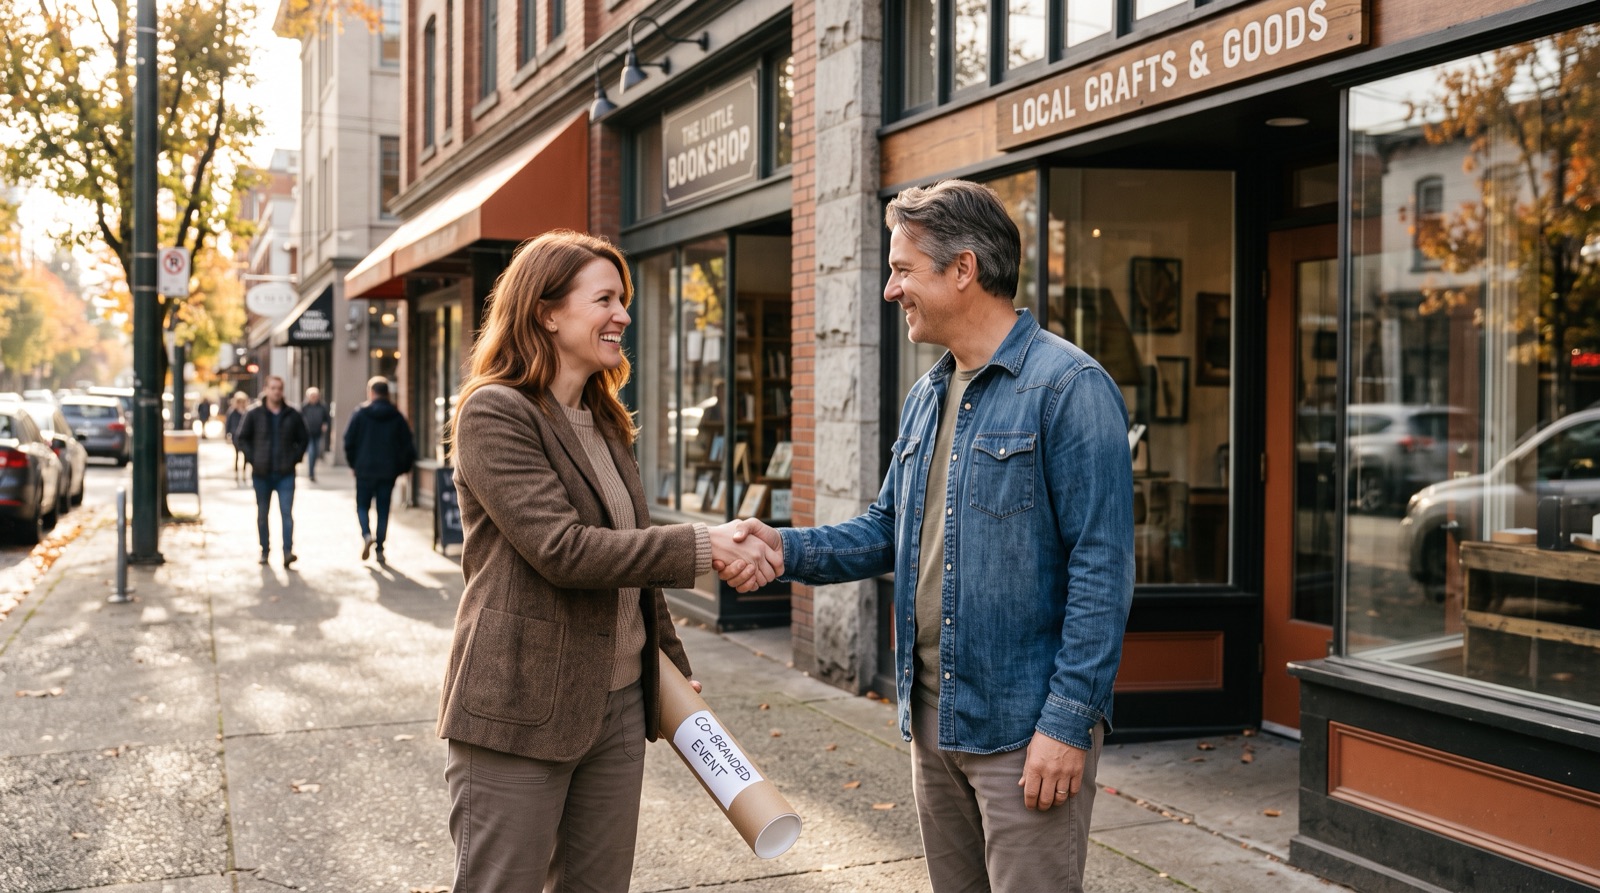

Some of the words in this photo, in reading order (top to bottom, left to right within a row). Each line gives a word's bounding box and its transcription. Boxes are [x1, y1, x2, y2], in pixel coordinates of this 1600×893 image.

[1012, 85, 1076, 134] LOCAL
[1084, 50, 1177, 112] CRAFTS
[1188, 40, 1211, 80] &
[1222, 0, 1329, 68] GOODS
[668, 125, 750, 189] BOOKSHOP
[681, 120, 700, 147] THE
[701, 104, 734, 138] LITTLE
[691, 738, 728, 777] EVENT
[694, 716, 751, 782] CO-BRANDED
